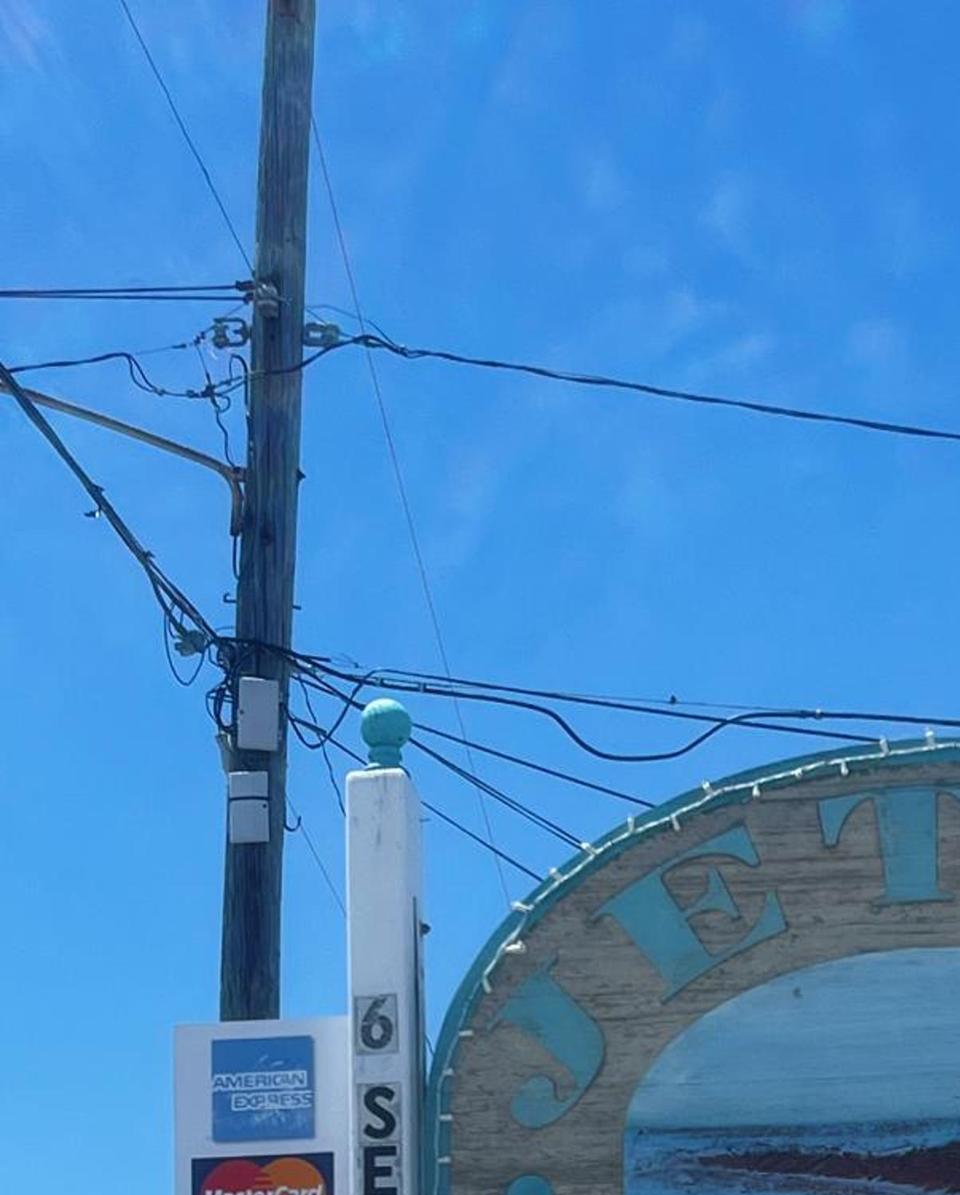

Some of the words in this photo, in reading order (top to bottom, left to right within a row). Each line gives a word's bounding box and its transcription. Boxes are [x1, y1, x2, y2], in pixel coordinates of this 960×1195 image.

[361, 996, 394, 1051] 6
[213, 1073, 306, 1090] AMERICAN
[233, 1092, 313, 1110] EXPRESS
